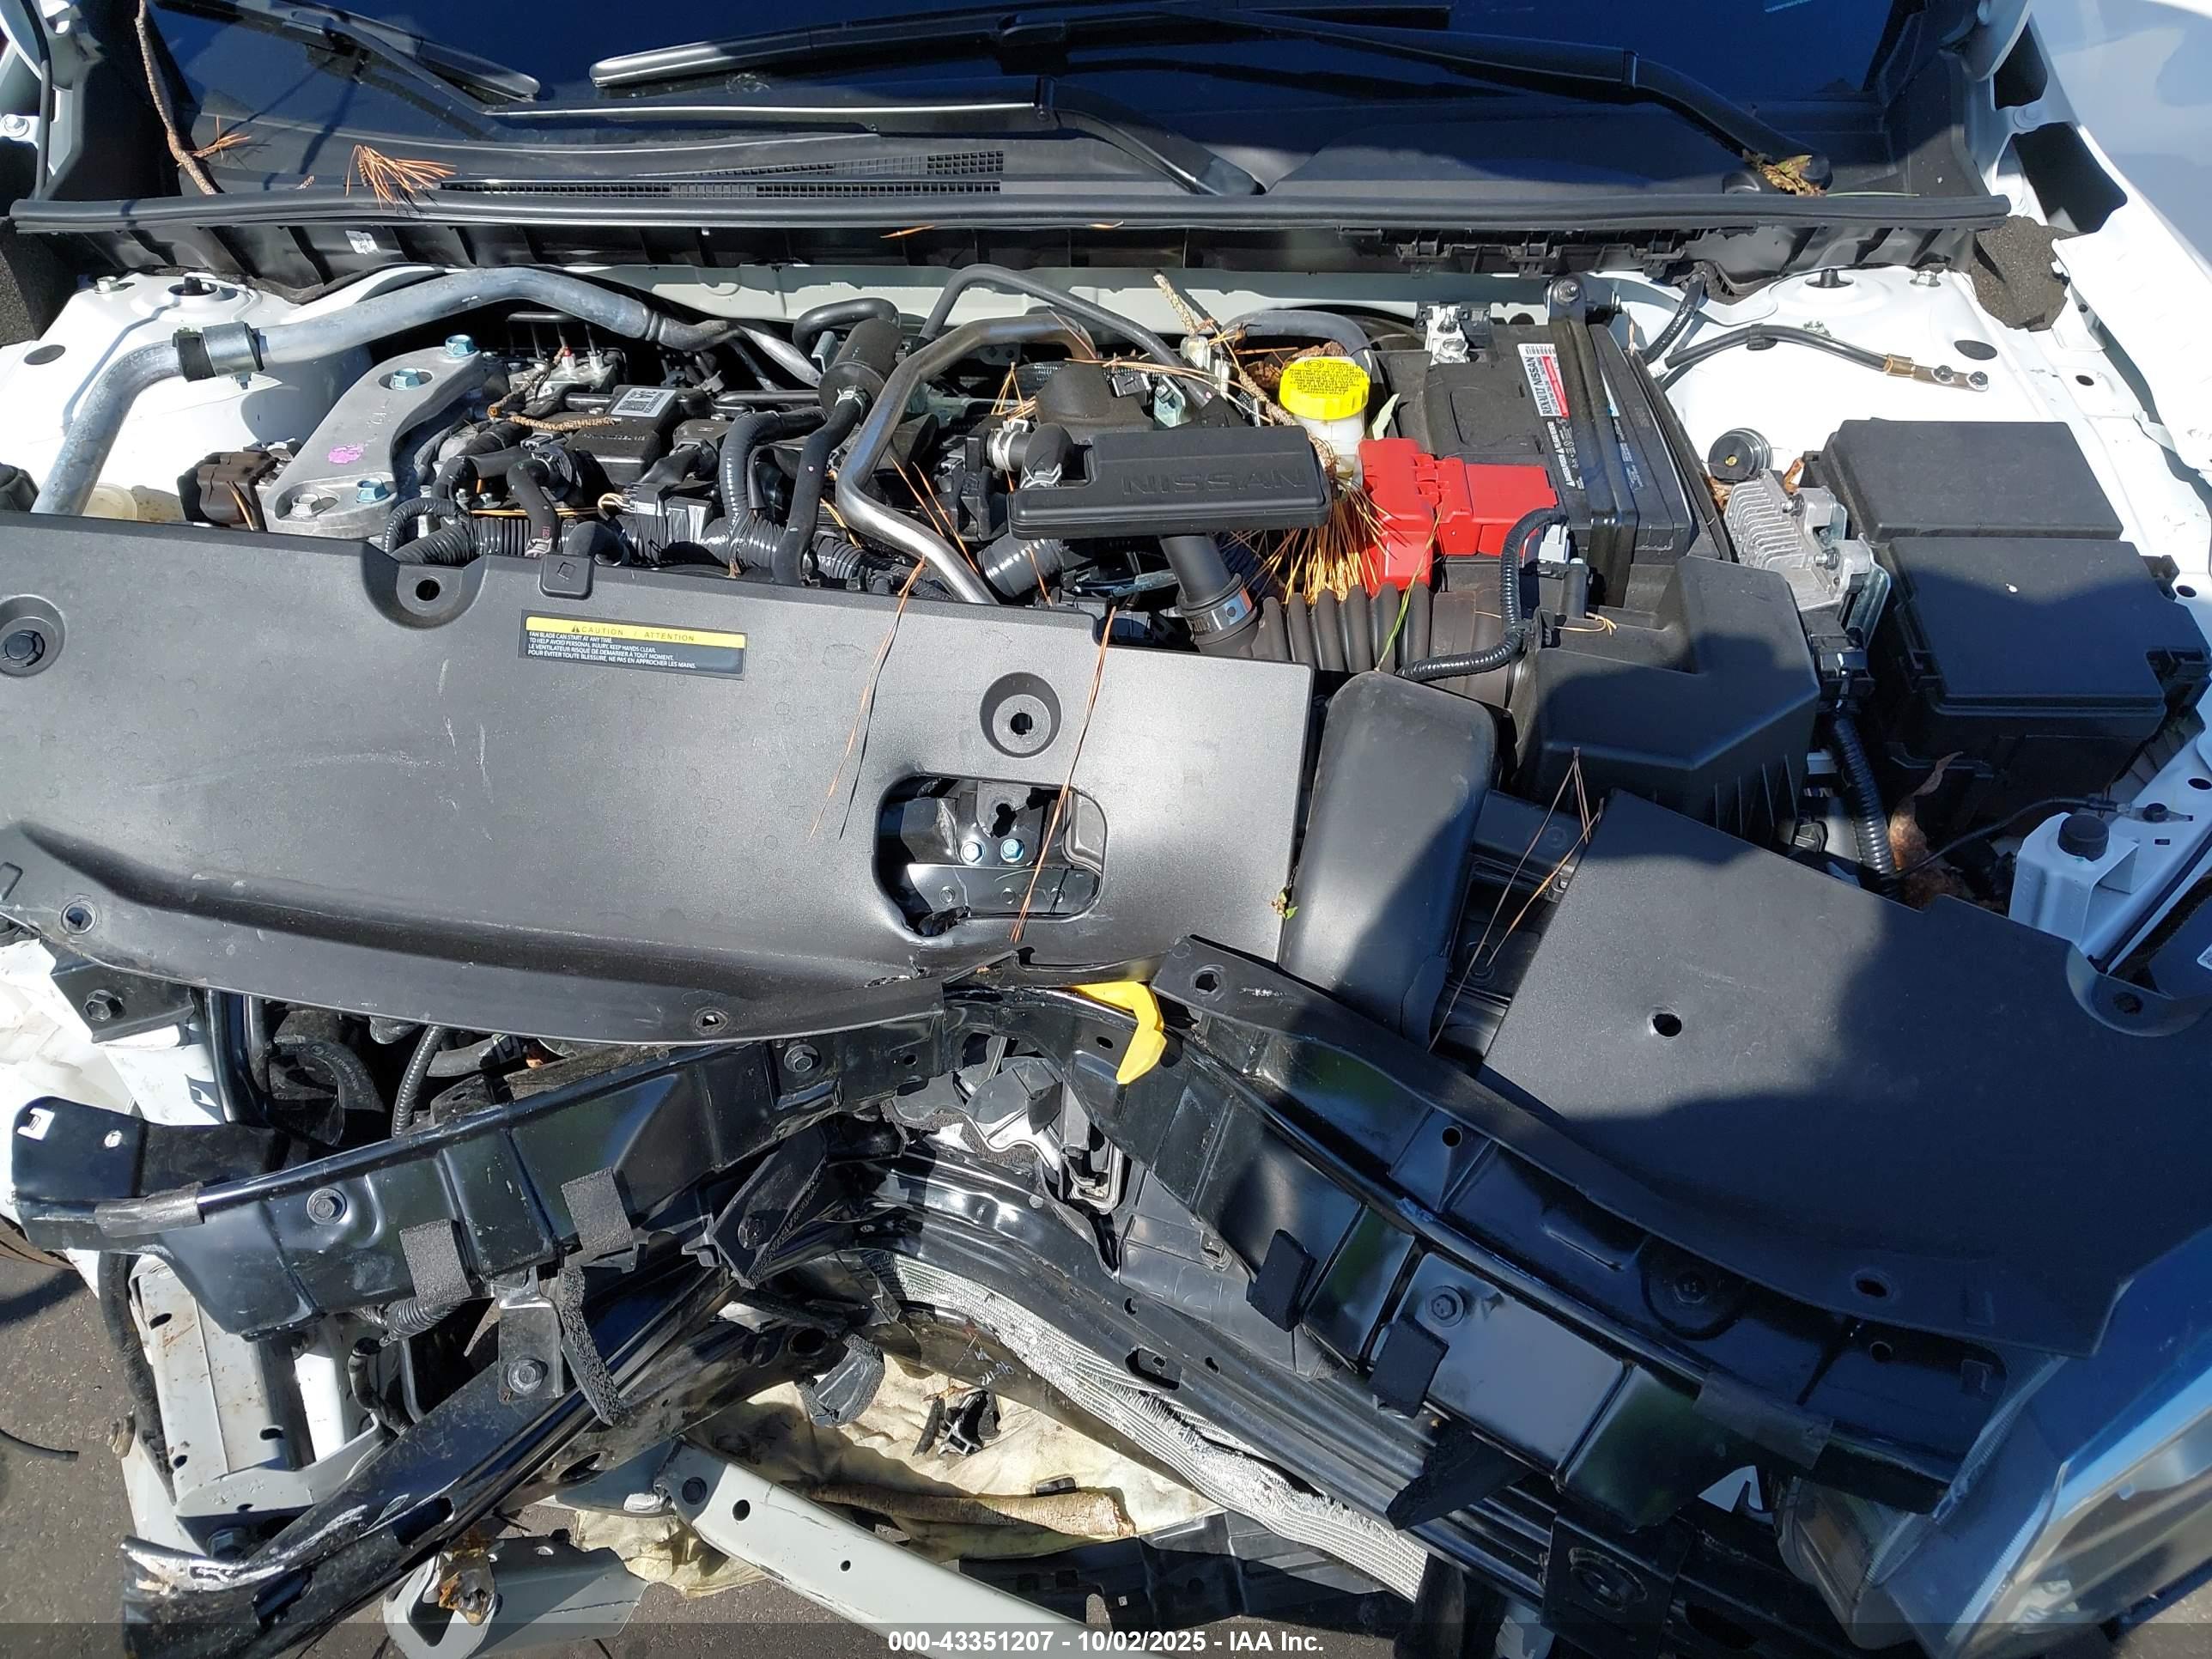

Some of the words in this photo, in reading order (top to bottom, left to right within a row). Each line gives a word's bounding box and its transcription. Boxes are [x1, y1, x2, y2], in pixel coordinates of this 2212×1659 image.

[1525, 356, 1543, 386] NISSAN
[1535, 387, 1553, 415] RENAULT
[1121, 467, 1307, 495] NISSAN
[581, 626, 623, 635] CAUTION
[644, 631, 695, 641] ATTENTION
